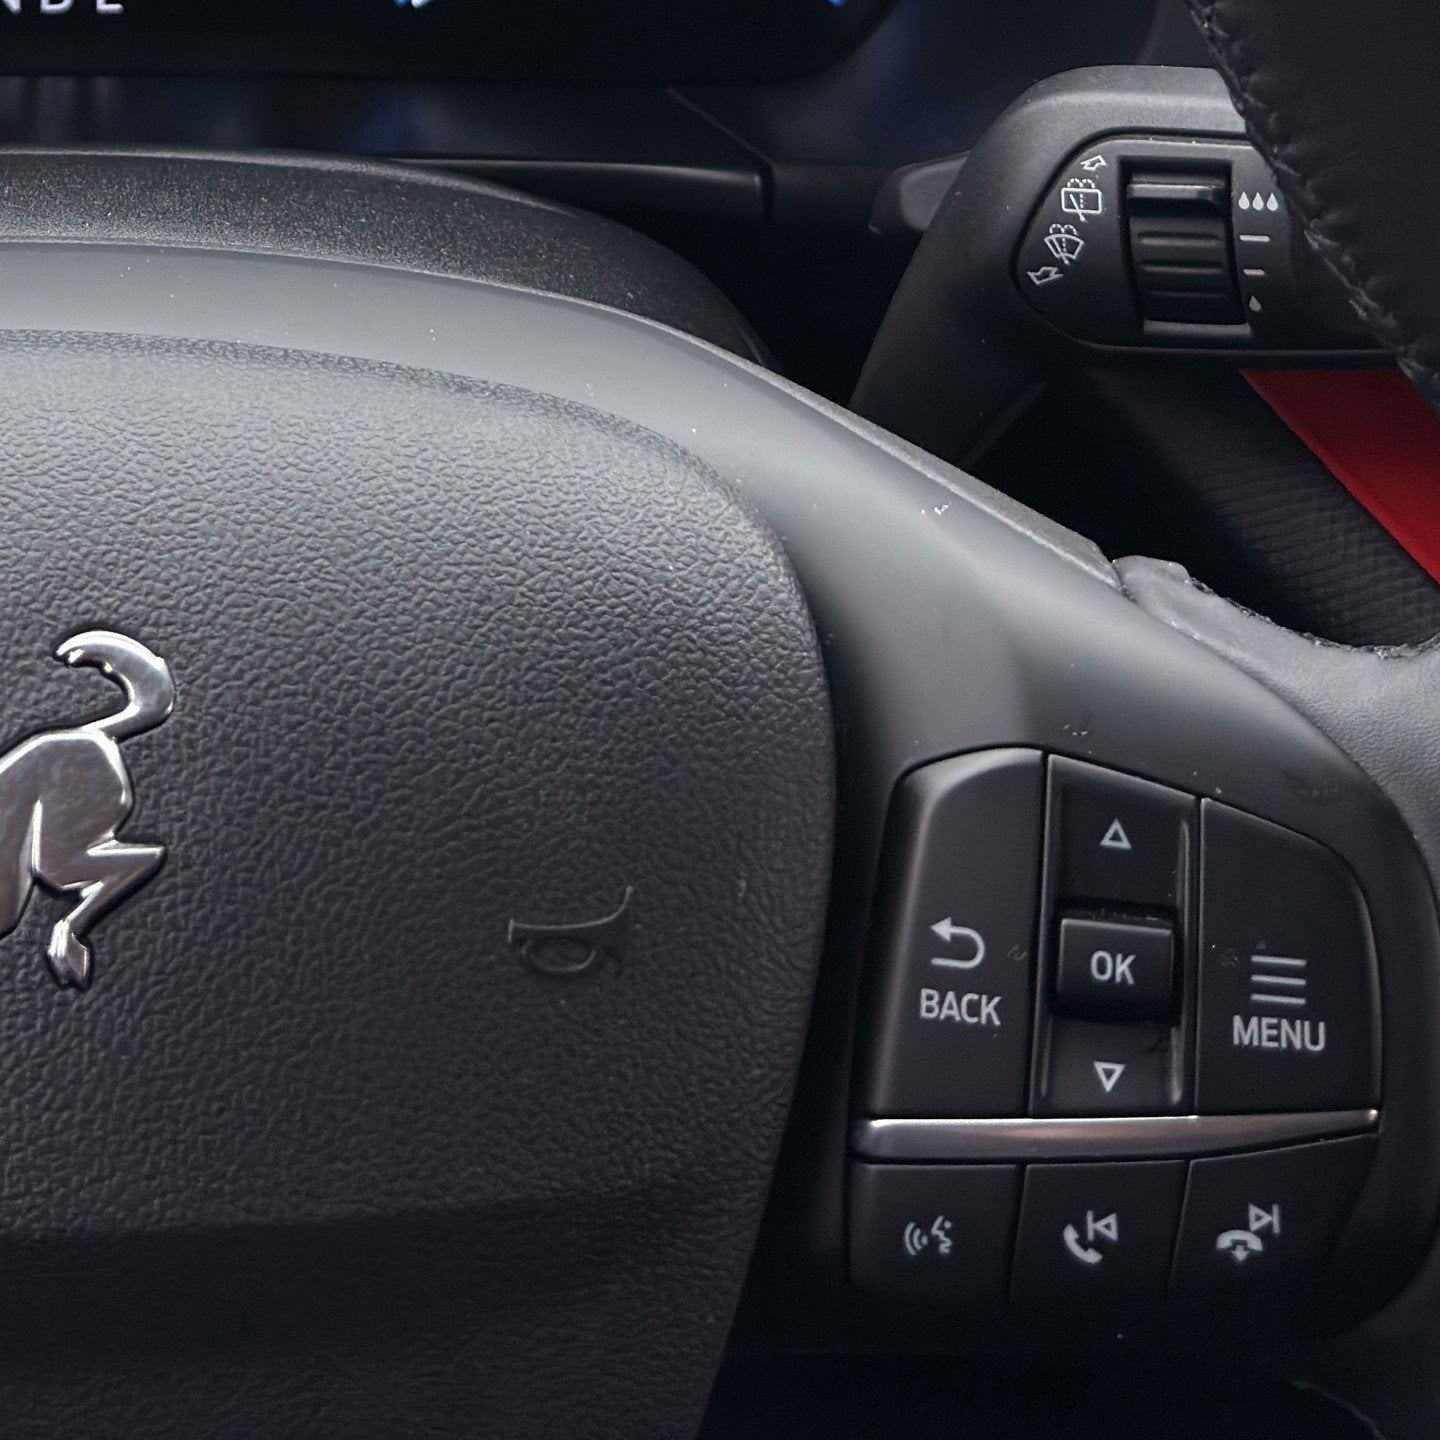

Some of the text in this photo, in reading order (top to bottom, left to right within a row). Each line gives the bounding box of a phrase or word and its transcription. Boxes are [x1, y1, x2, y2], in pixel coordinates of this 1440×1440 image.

[1090, 950, 1135, 985] OK
[919, 987, 1001, 1026] BACK
[1232, 1014, 1326, 1053] MENU
